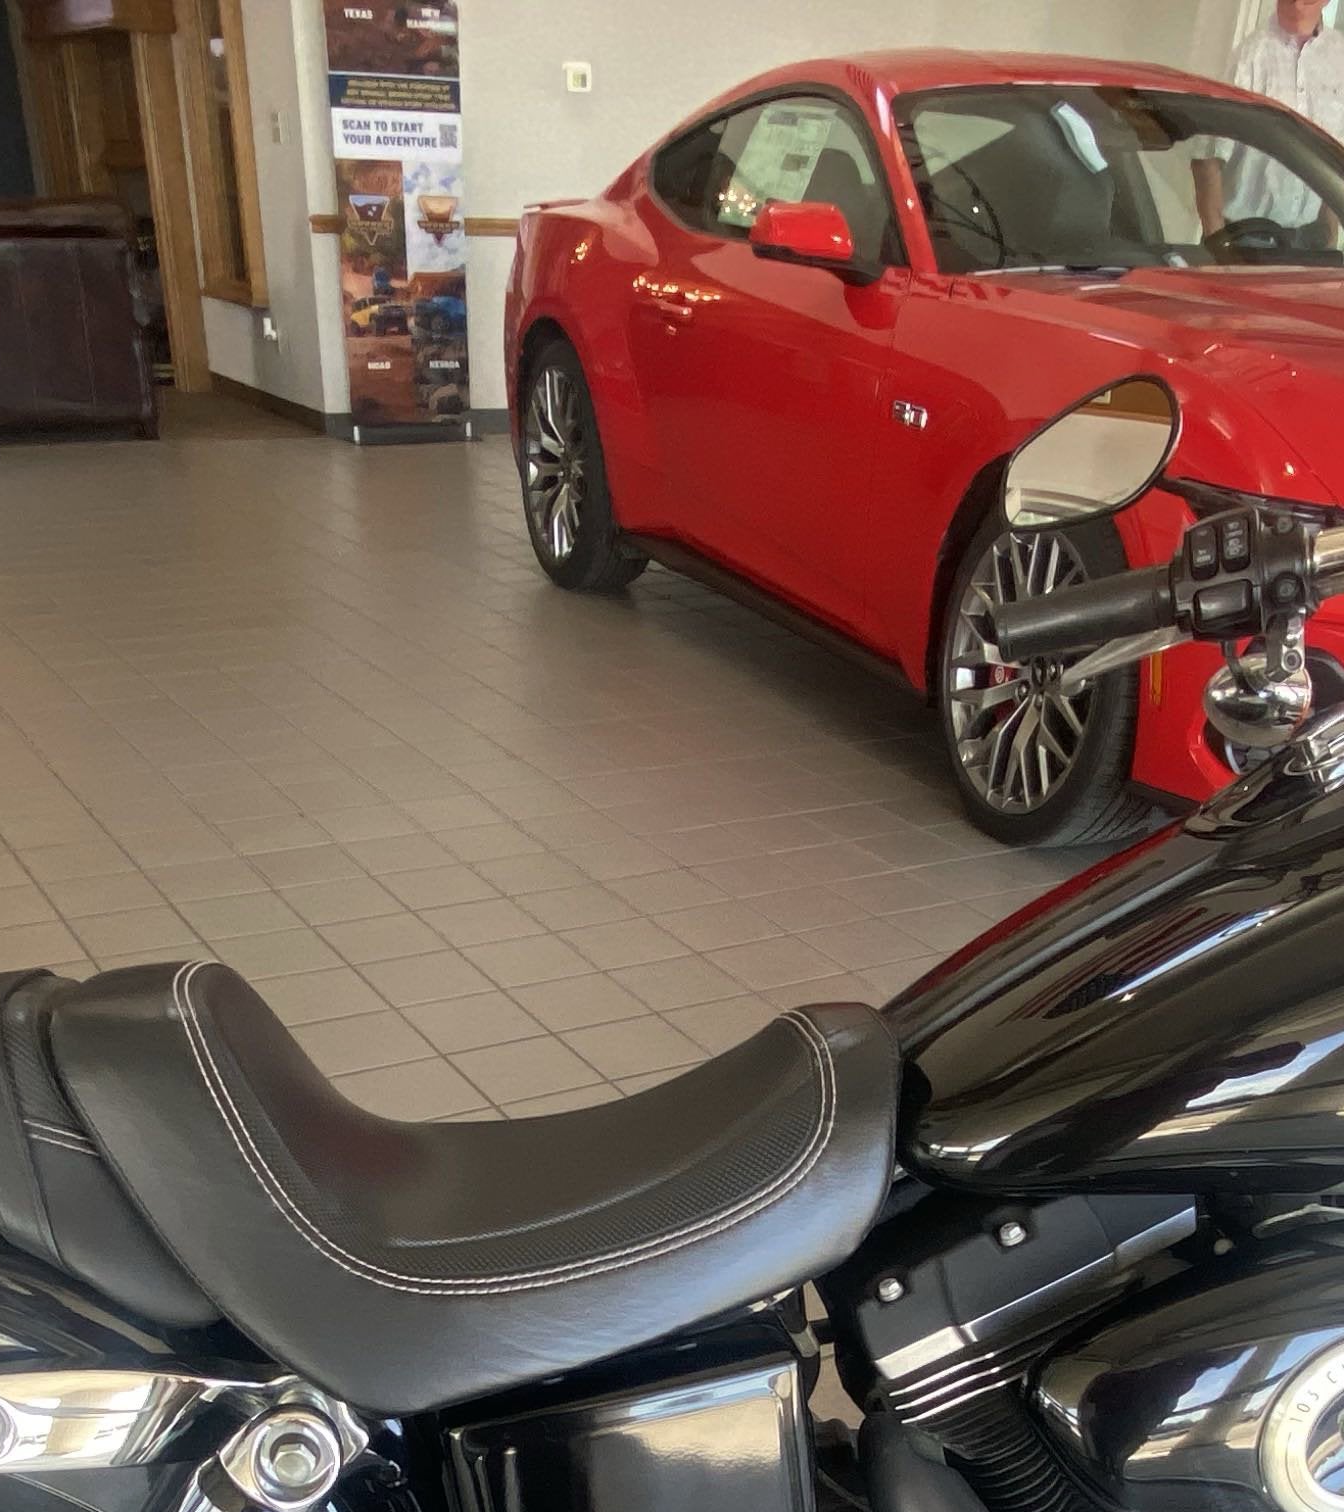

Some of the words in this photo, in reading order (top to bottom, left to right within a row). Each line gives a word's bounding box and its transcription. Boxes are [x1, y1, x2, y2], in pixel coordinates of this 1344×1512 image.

[344, 8, 373, 20] TEXAS
[342, 119, 371, 131] SCAN
[374, 121, 388, 132] TO
[391, 121, 424, 133] START
[343, 134, 372, 145] YOUR
[375, 135, 437, 148] ADVENTURE
